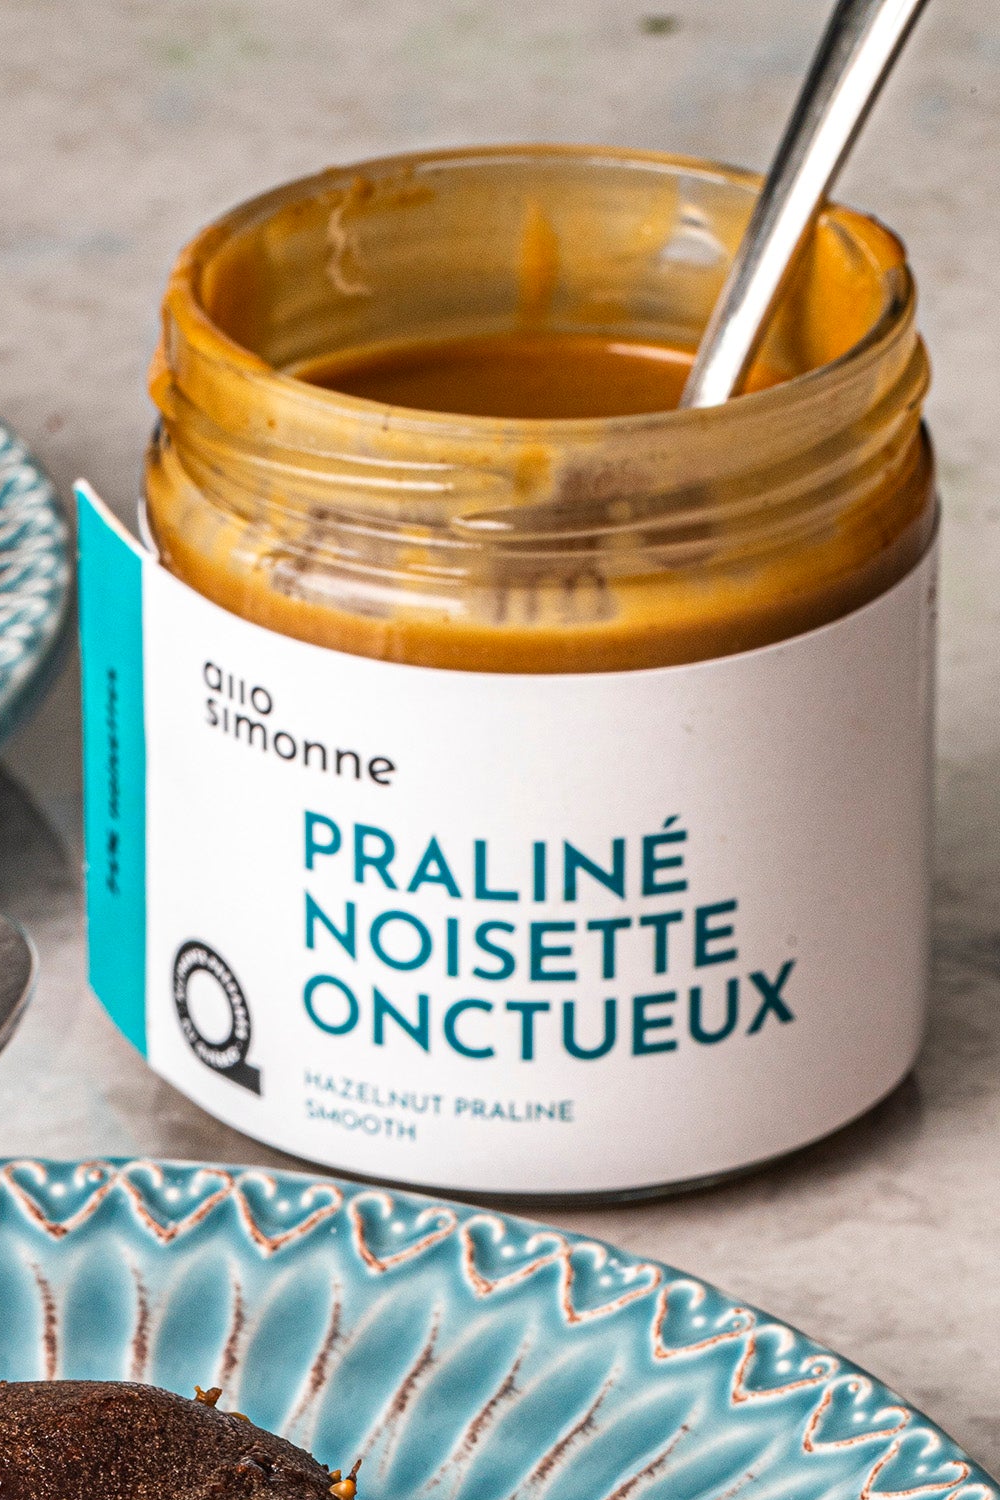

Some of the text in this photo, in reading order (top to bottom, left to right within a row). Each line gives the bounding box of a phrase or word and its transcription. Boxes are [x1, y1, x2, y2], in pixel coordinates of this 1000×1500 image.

[206, 698, 396, 785] simonne
[304, 809, 689, 902] PRALINÉ
[304, 888, 739, 982] NOISETTE
[303, 958, 796, 1062] ONCTUEUX
[304, 1070, 444, 1115] HAZELNUT
[304, 1098, 417, 1141] SMOOTH
